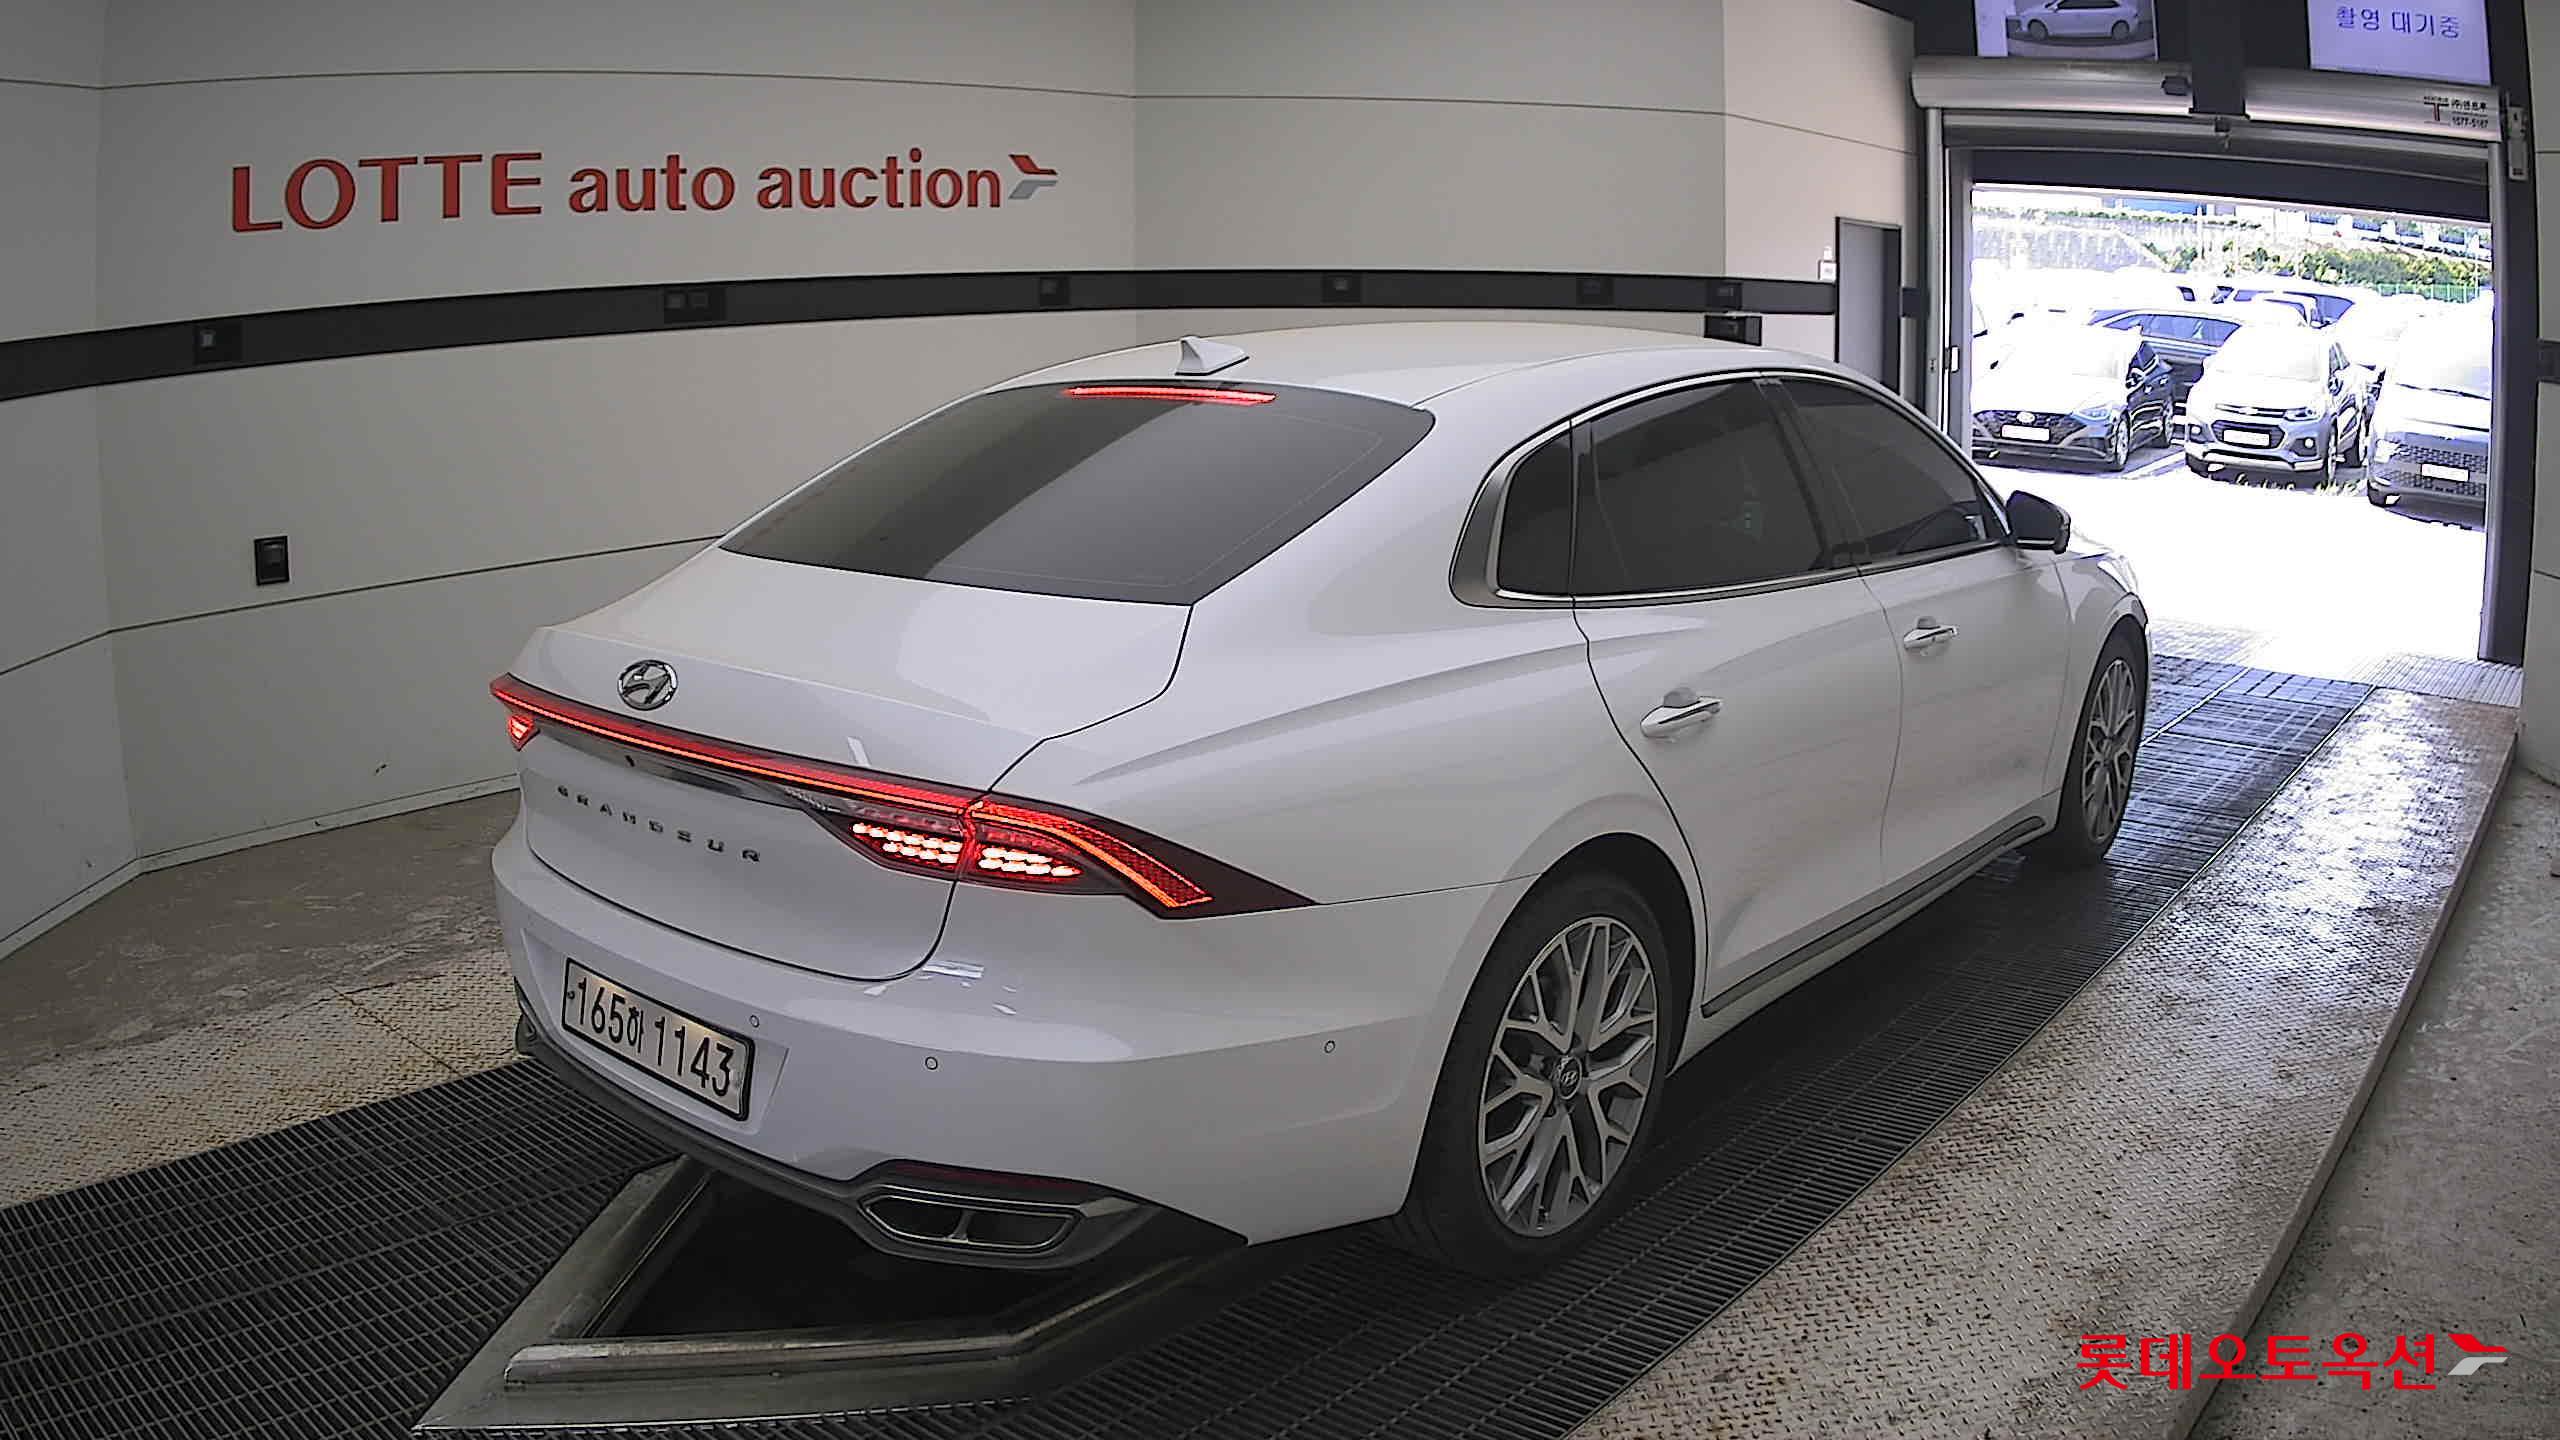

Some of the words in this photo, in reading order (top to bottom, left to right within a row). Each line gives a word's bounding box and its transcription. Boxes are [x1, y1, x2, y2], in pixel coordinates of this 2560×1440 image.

[2336, 6, 2380, 31] 촬영
[2391, 11, 2459, 39] 대기중
[231, 152, 542, 233] LOTTE
[568, 154, 736, 213] auto
[757, 148, 1002, 208] auction
[557, 785, 760, 862] GRANDEUR
[578, 977, 645, 1054] 165하
[654, 1016, 735, 1097] 1143
